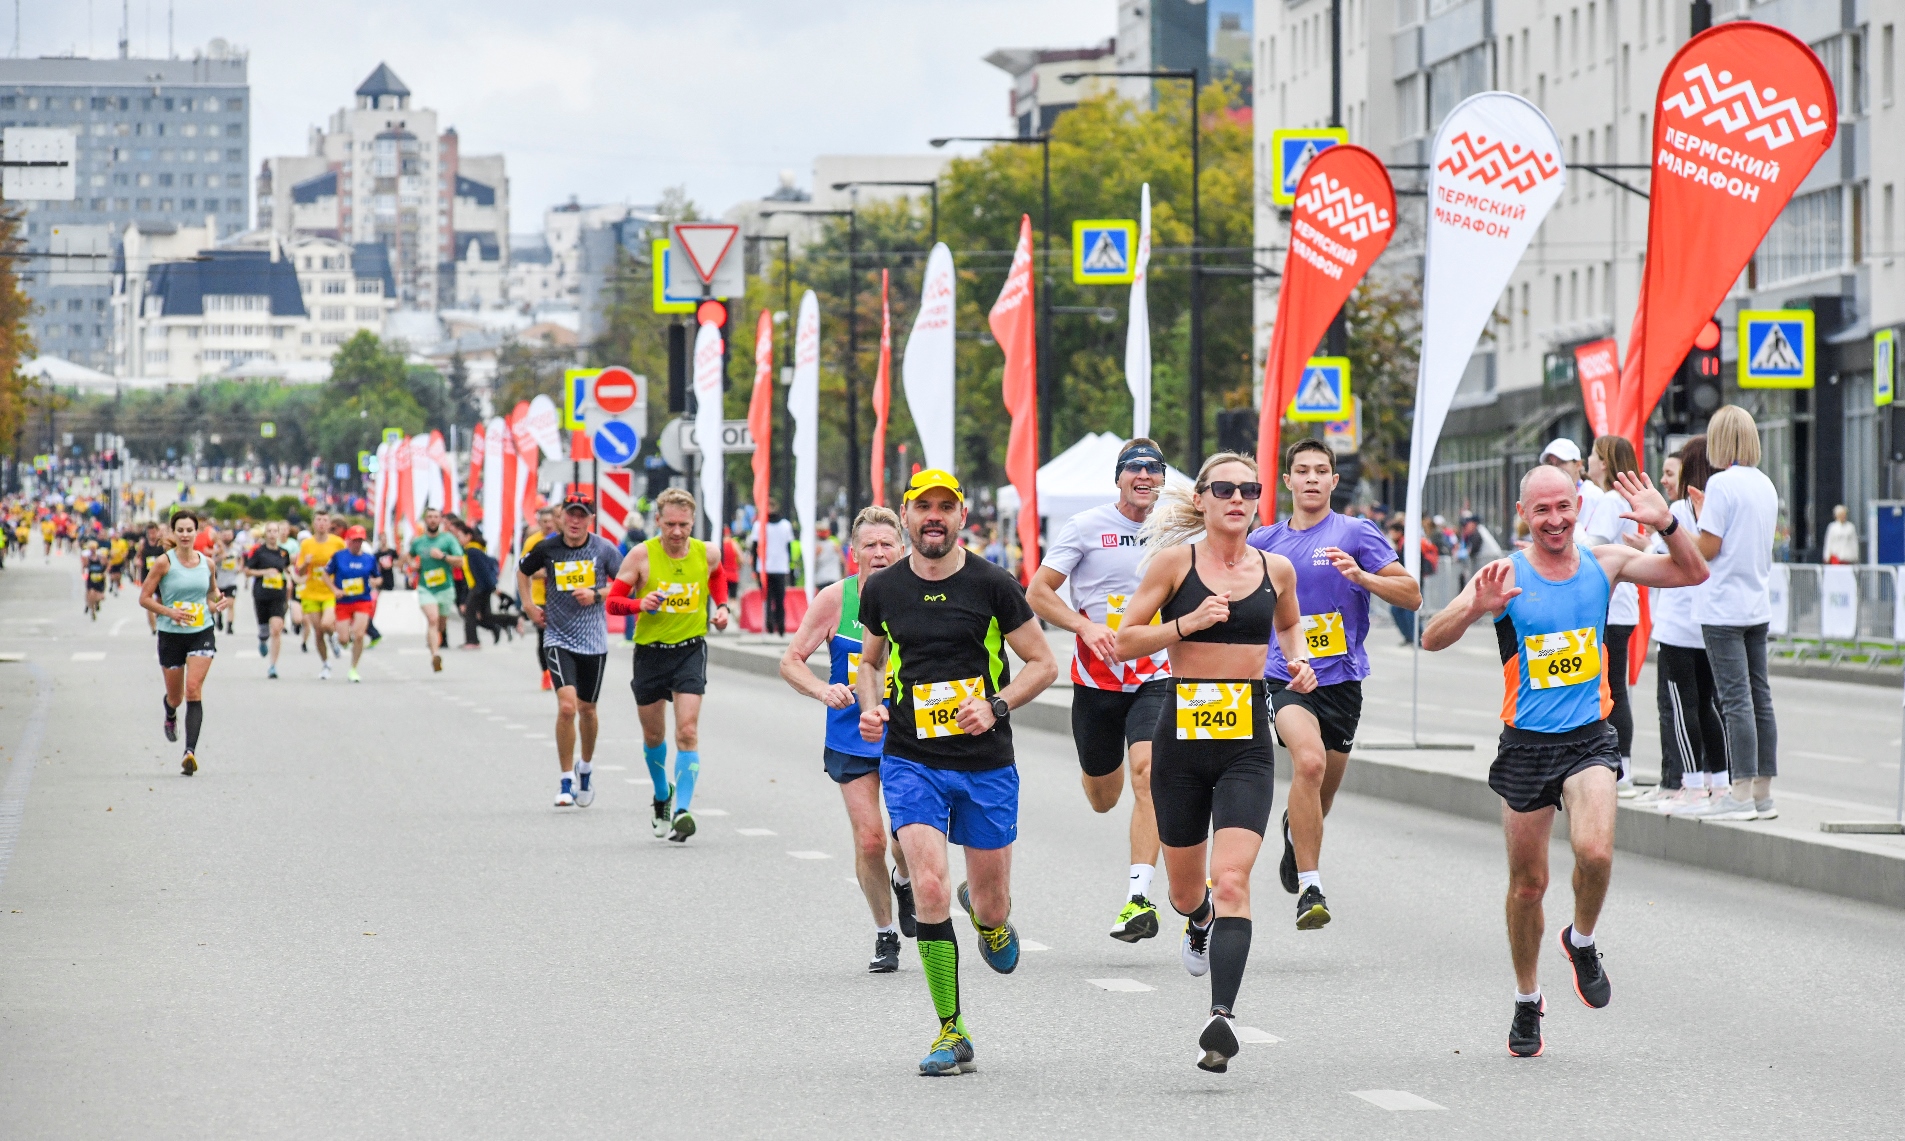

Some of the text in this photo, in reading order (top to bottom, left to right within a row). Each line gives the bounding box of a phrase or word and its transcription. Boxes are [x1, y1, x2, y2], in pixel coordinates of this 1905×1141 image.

[1665, 125, 1780, 183] ПЕРМСКИЙ
[1658, 148, 1760, 203] МАРАФОН
[1438, 185, 1527, 220] ПЕРМСКИЙ
[1434, 207, 1510, 239] МАРАФОН
[566, 575, 585, 584] 558
[666, 597, 691, 607] 1604
[1548, 656, 1583, 676] 689
[928, 707, 960, 725] 184
[1192, 710, 1237, 727] 1240
